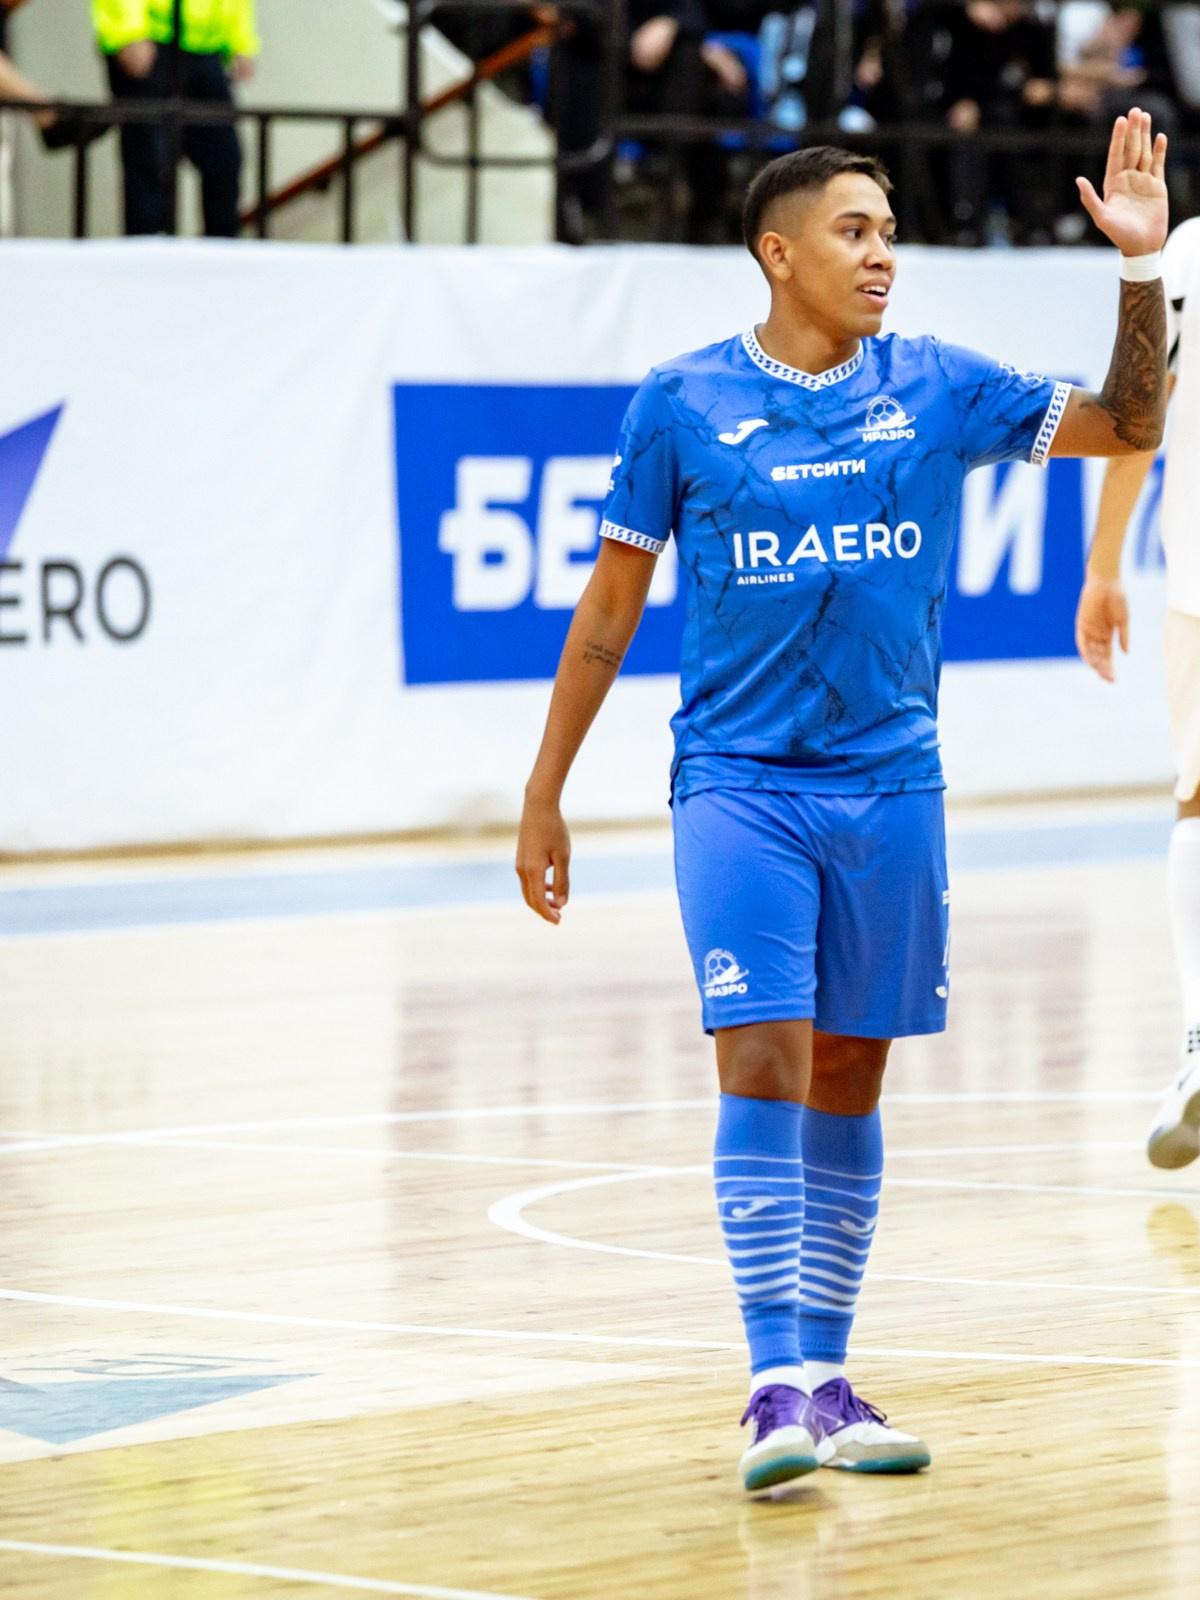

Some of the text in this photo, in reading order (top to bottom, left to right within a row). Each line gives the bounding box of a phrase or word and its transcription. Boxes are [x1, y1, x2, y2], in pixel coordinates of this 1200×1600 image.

[862, 429, 916, 443] ИРАЭРО
[770, 459, 866, 481] БЕТСИТИ
[733, 521, 922, 569] IRAERO
[737, 572, 795, 585] AIRLINES
